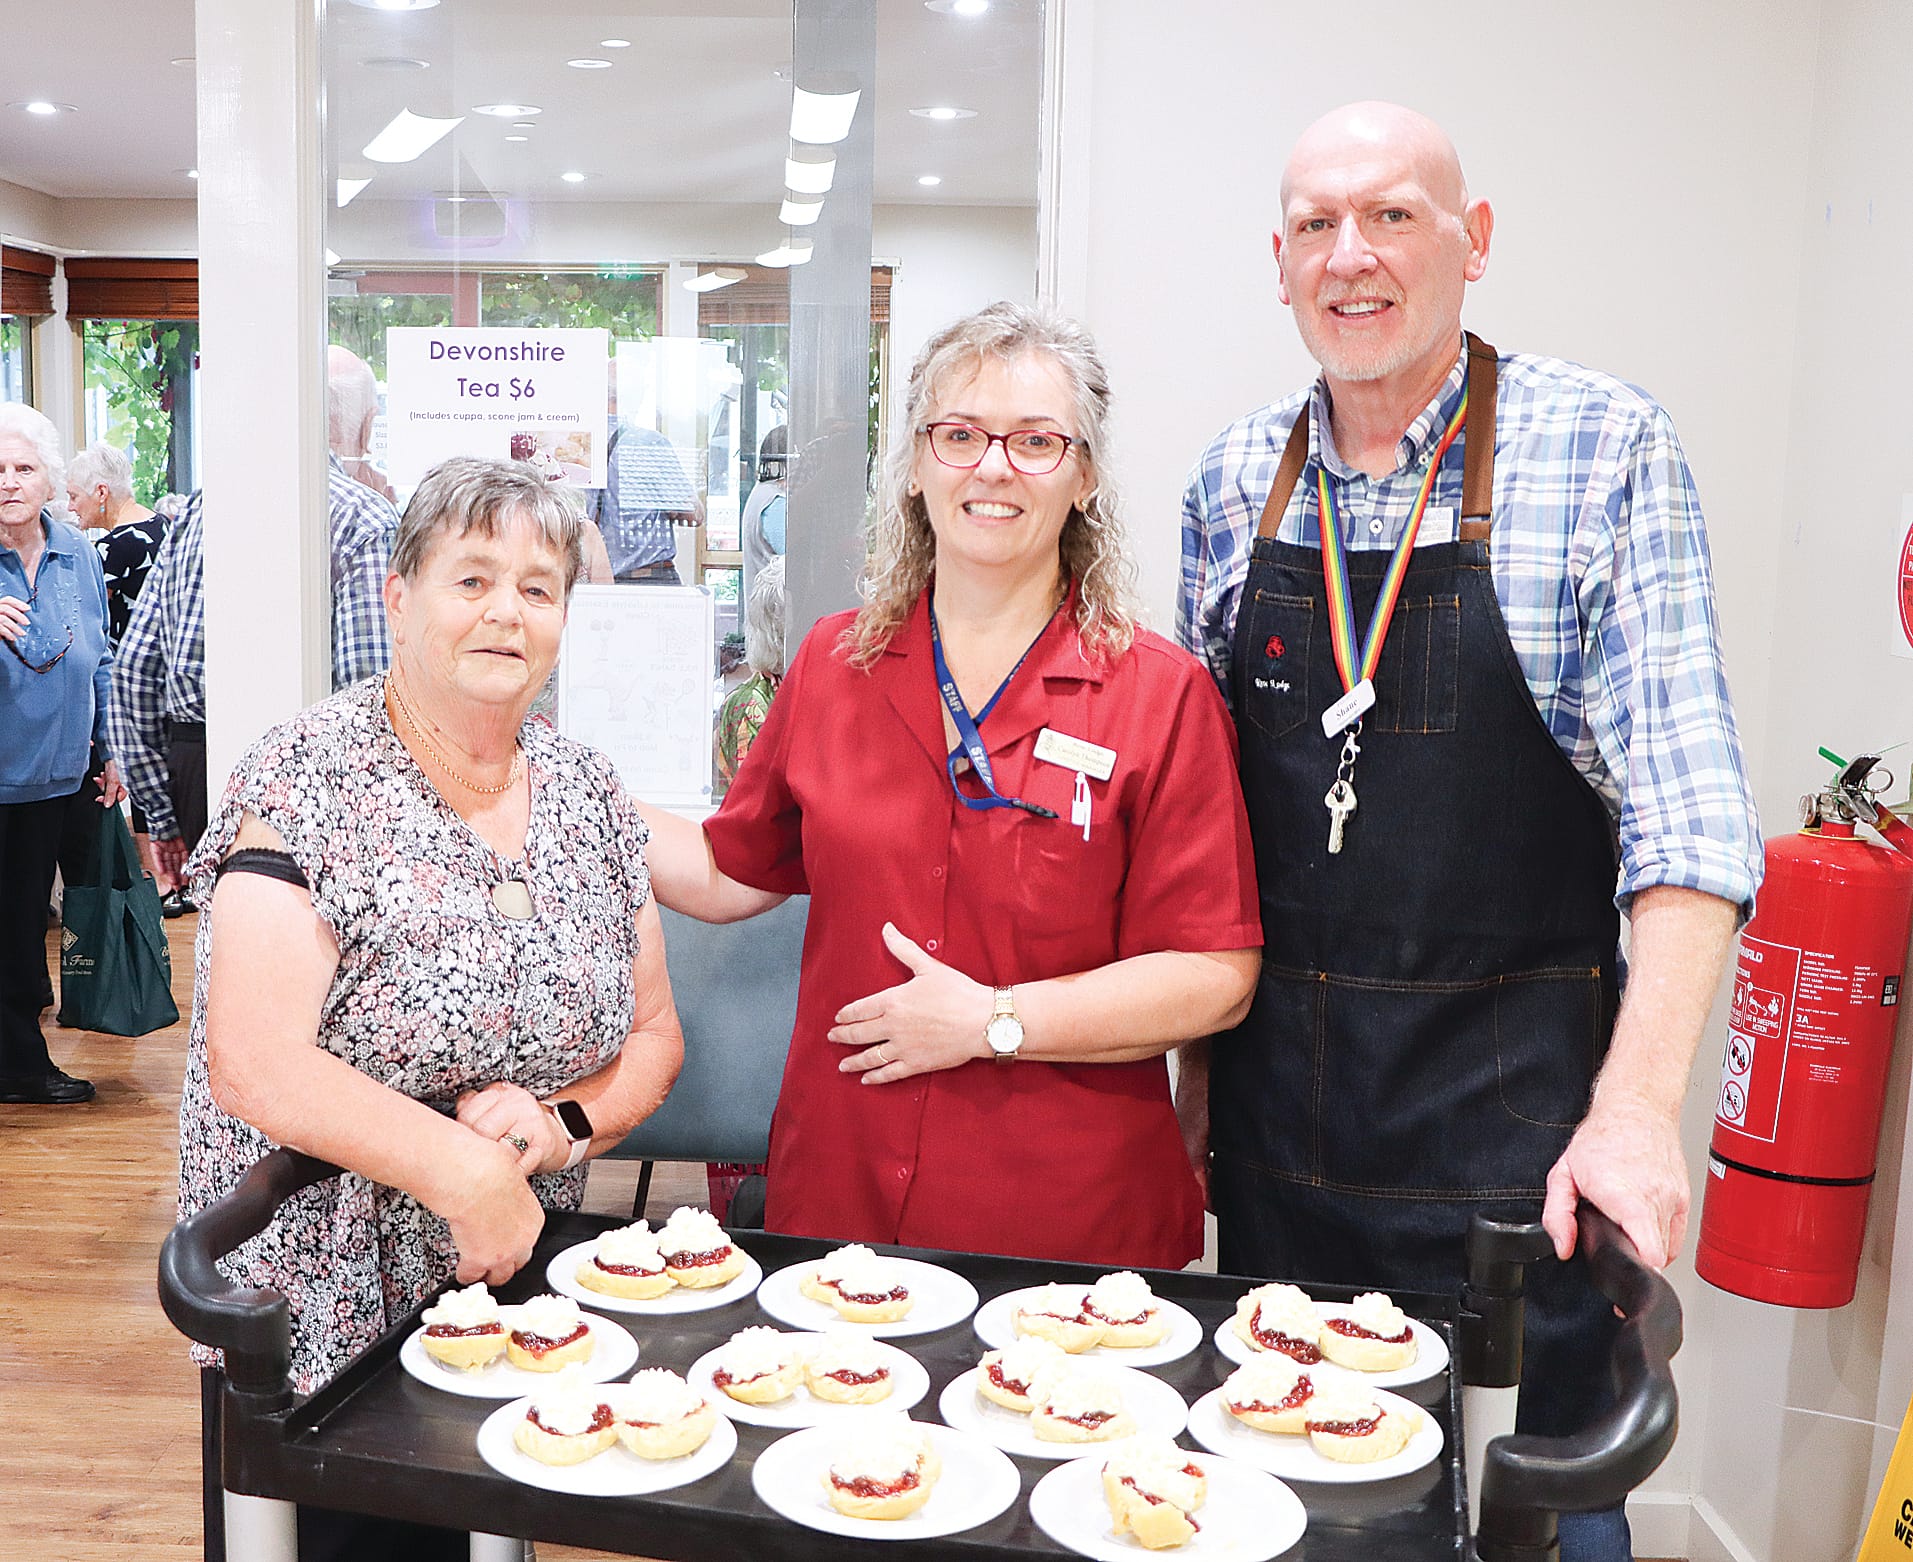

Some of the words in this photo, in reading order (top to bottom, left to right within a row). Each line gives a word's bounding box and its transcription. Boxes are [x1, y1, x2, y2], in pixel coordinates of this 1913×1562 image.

[430, 341, 566, 362] Devonshire
[457, 377, 500, 397] Tea
[509, 377, 536, 401] $6
[409, 411, 451, 421] (Includes
[453, 413, 486, 421] cuppa,
[488, 413, 516, 421] scone
[517, 412, 535, 422] jam
[537, 413, 543, 421] &
[546, 413, 580, 422] cream)
[942, 682, 964, 713] STAFF
[1335, 698, 1359, 720] Shane
[1795, 1013, 1809, 1024] 3A
